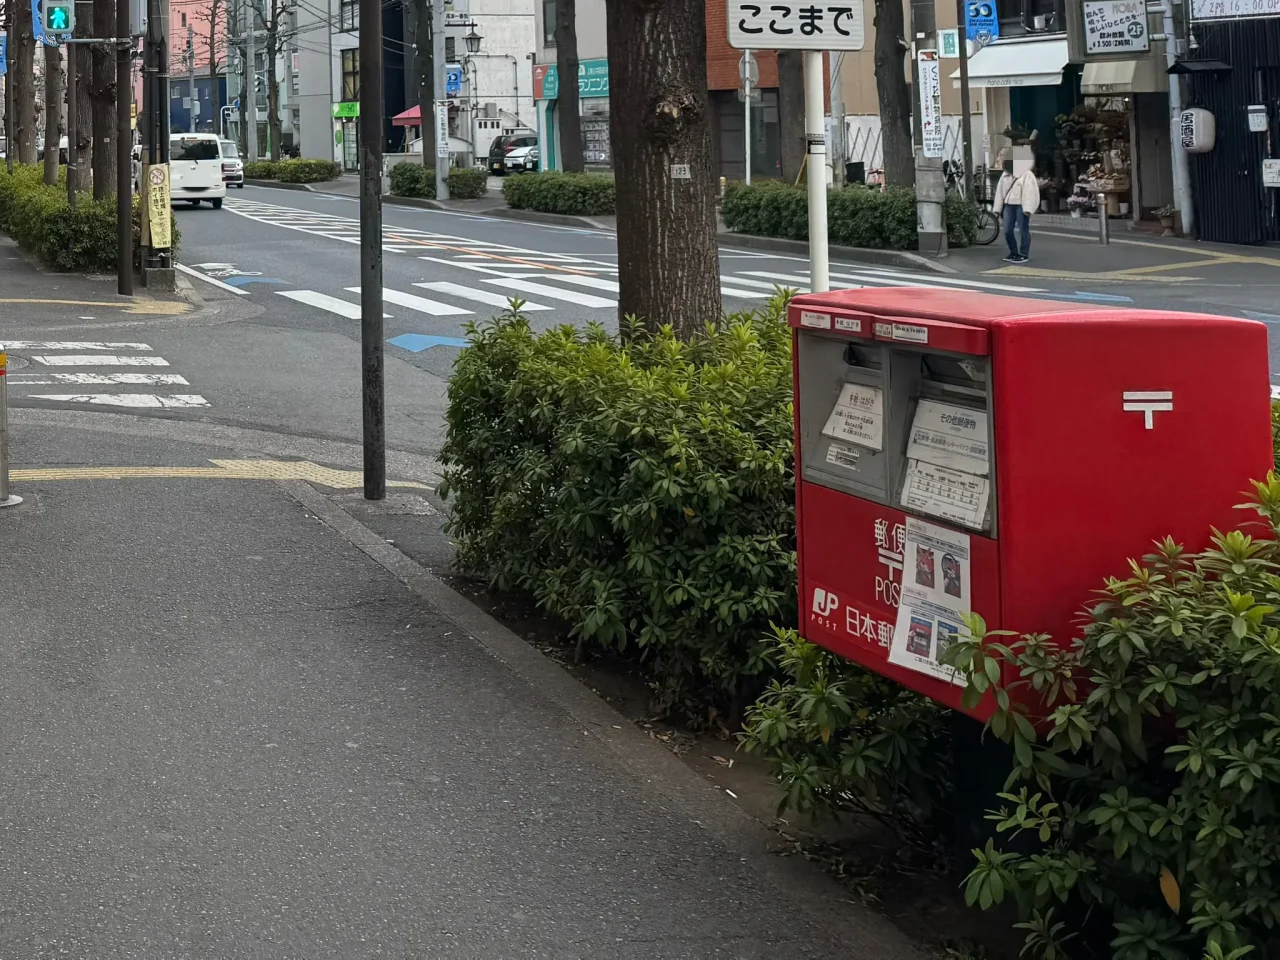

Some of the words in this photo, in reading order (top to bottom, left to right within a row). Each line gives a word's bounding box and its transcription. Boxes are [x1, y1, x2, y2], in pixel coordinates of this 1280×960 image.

[738, 4, 854, 37] ここまで
[1128, 24, 1143, 35] 2F
[1181, 111, 1195, 148] 居酒屋
[940, 413, 977, 430] その他郵便物
[874, 517, 906, 556] 郵便
[875, 576, 903, 608] POS
[811, 613, 837, 631] POST
